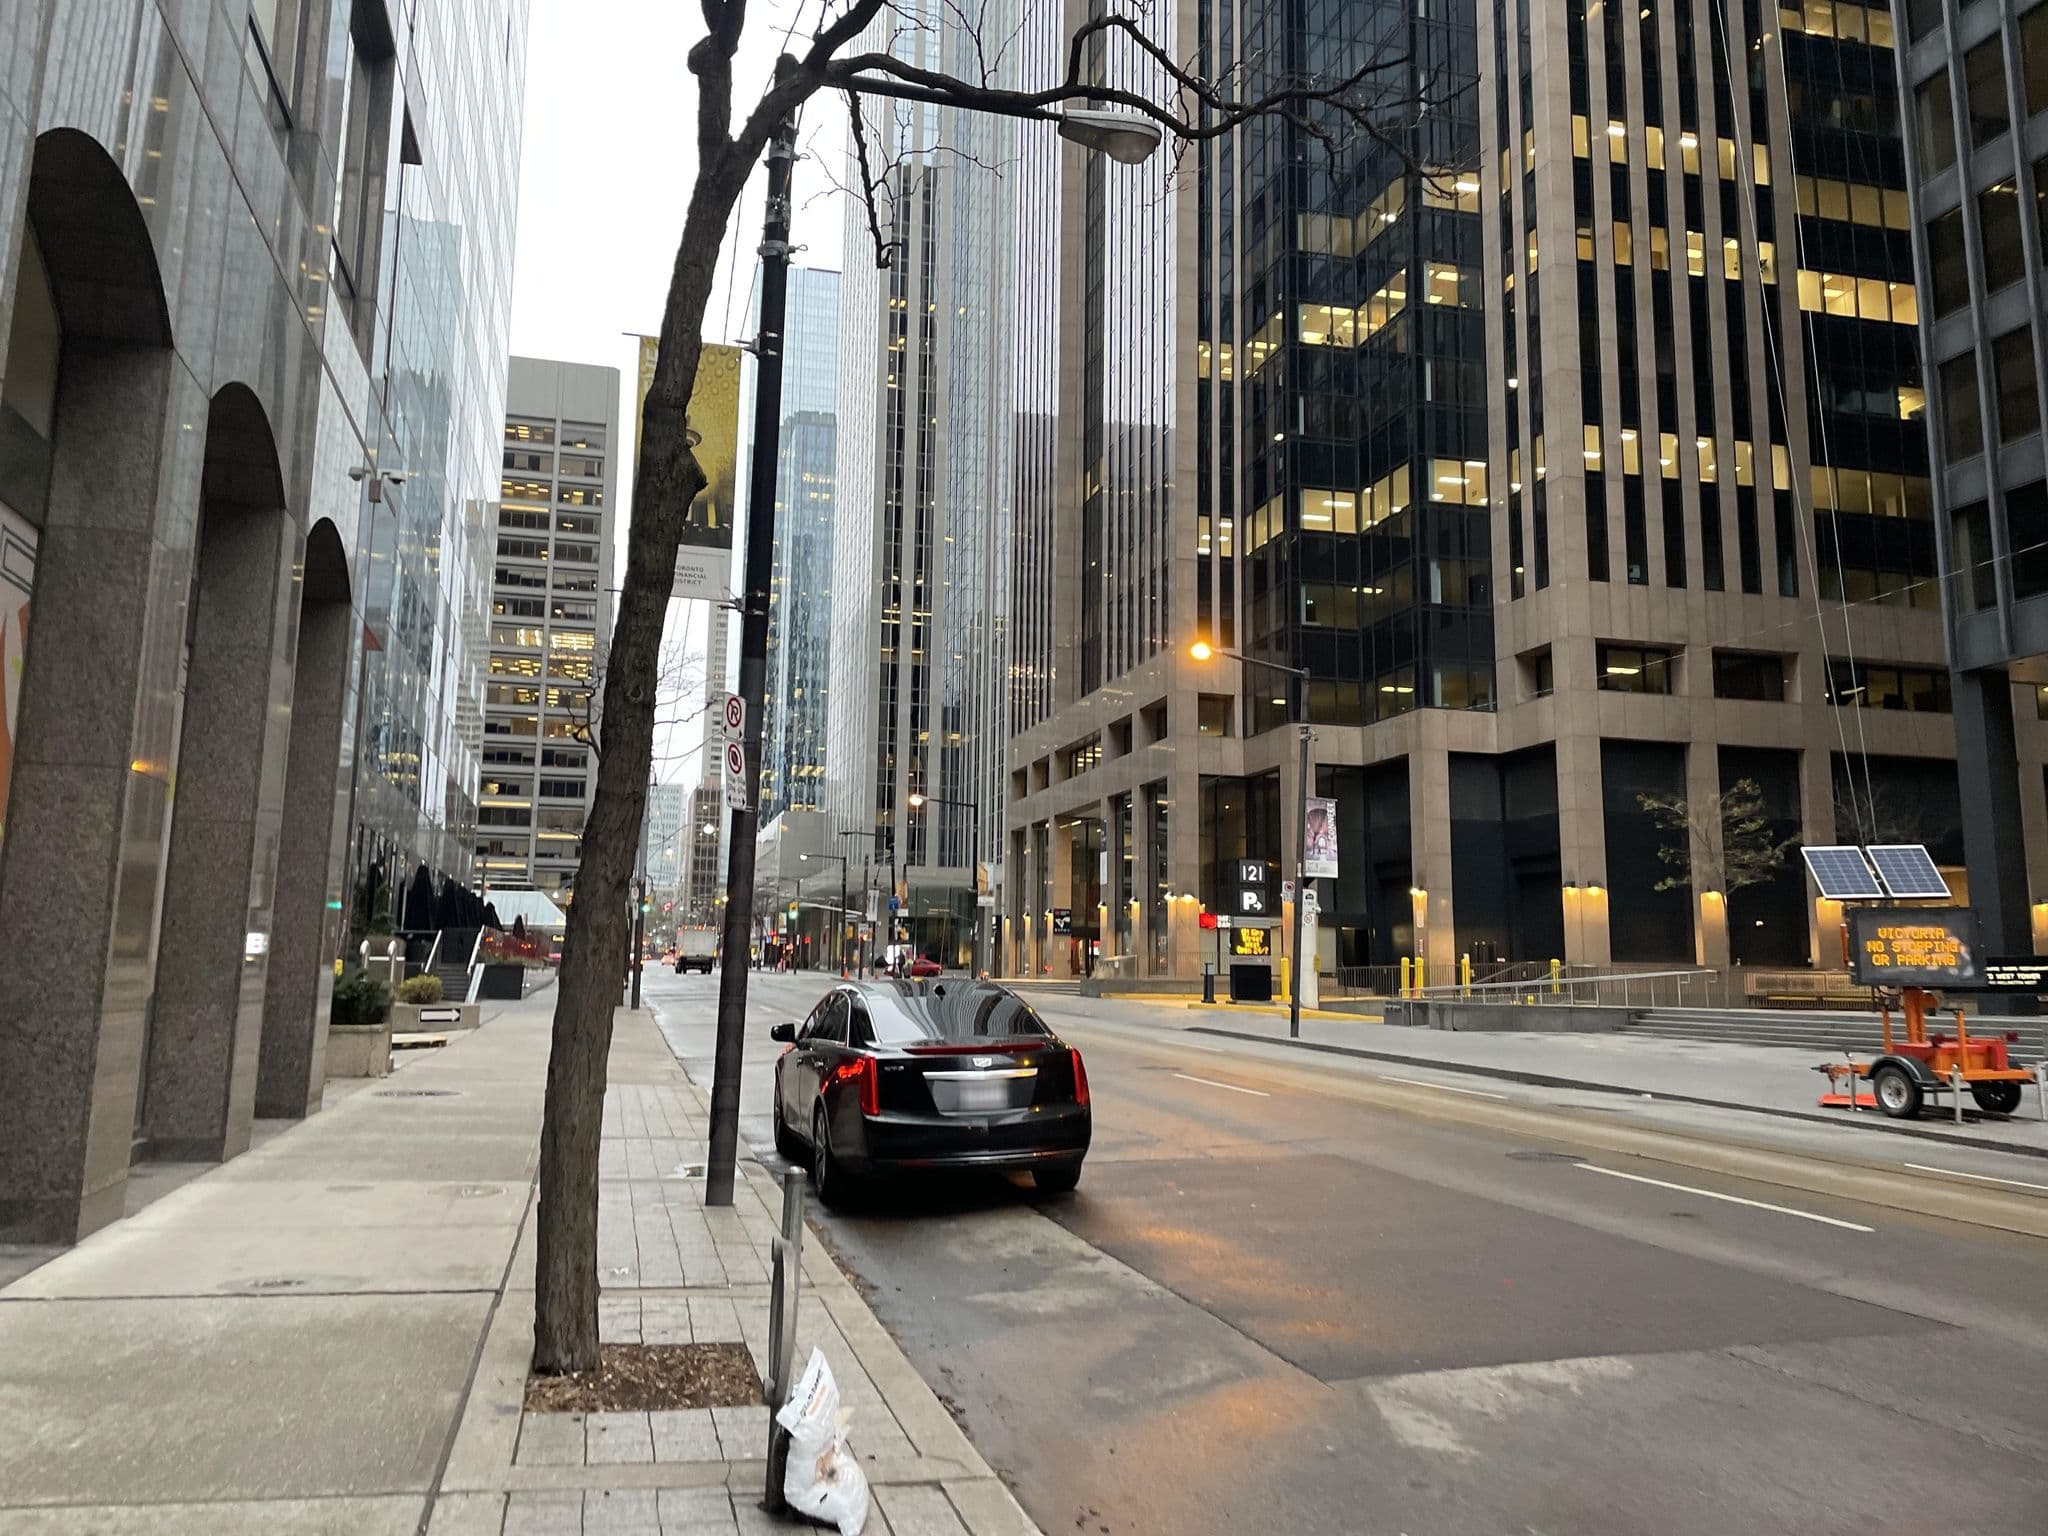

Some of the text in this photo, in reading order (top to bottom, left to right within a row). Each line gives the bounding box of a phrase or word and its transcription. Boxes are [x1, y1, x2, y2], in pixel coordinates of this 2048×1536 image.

[1242, 865, 1263, 881] 121
[1243, 892, 1257, 910] P
[1878, 927, 1944, 939] VICTORIA
[1866, 941, 1958, 953] NO STOPPING
[1872, 954, 1956, 966] OR PARKING
